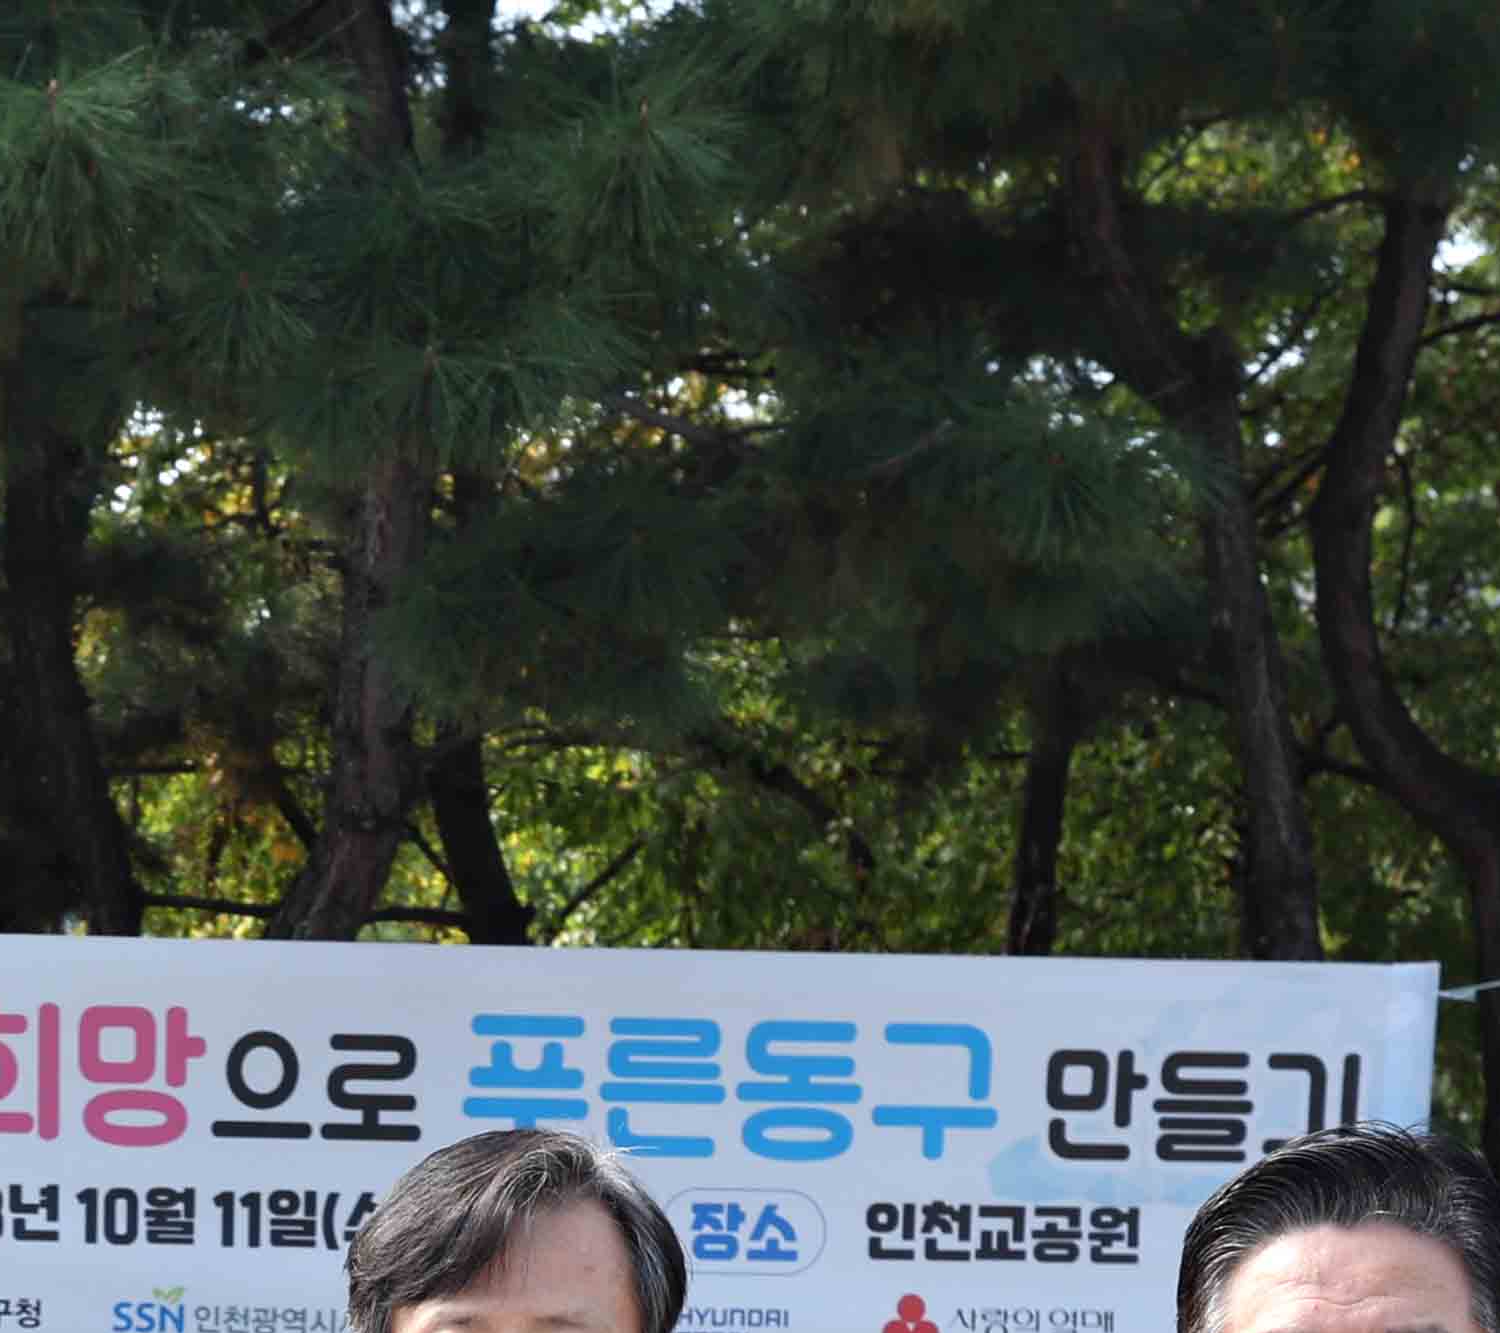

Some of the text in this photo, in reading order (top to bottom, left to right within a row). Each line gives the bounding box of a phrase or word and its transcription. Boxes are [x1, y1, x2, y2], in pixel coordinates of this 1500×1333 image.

[462, 1013, 999, 1162] 푸른동구
[1045, 1049, 1362, 1163] 만들기
[75, 1186, 195, 1246] 10월
[691, 1201, 1141, 1265] 장소 인천교공원
[679, 1308, 790, 1328] HYUNDAI
